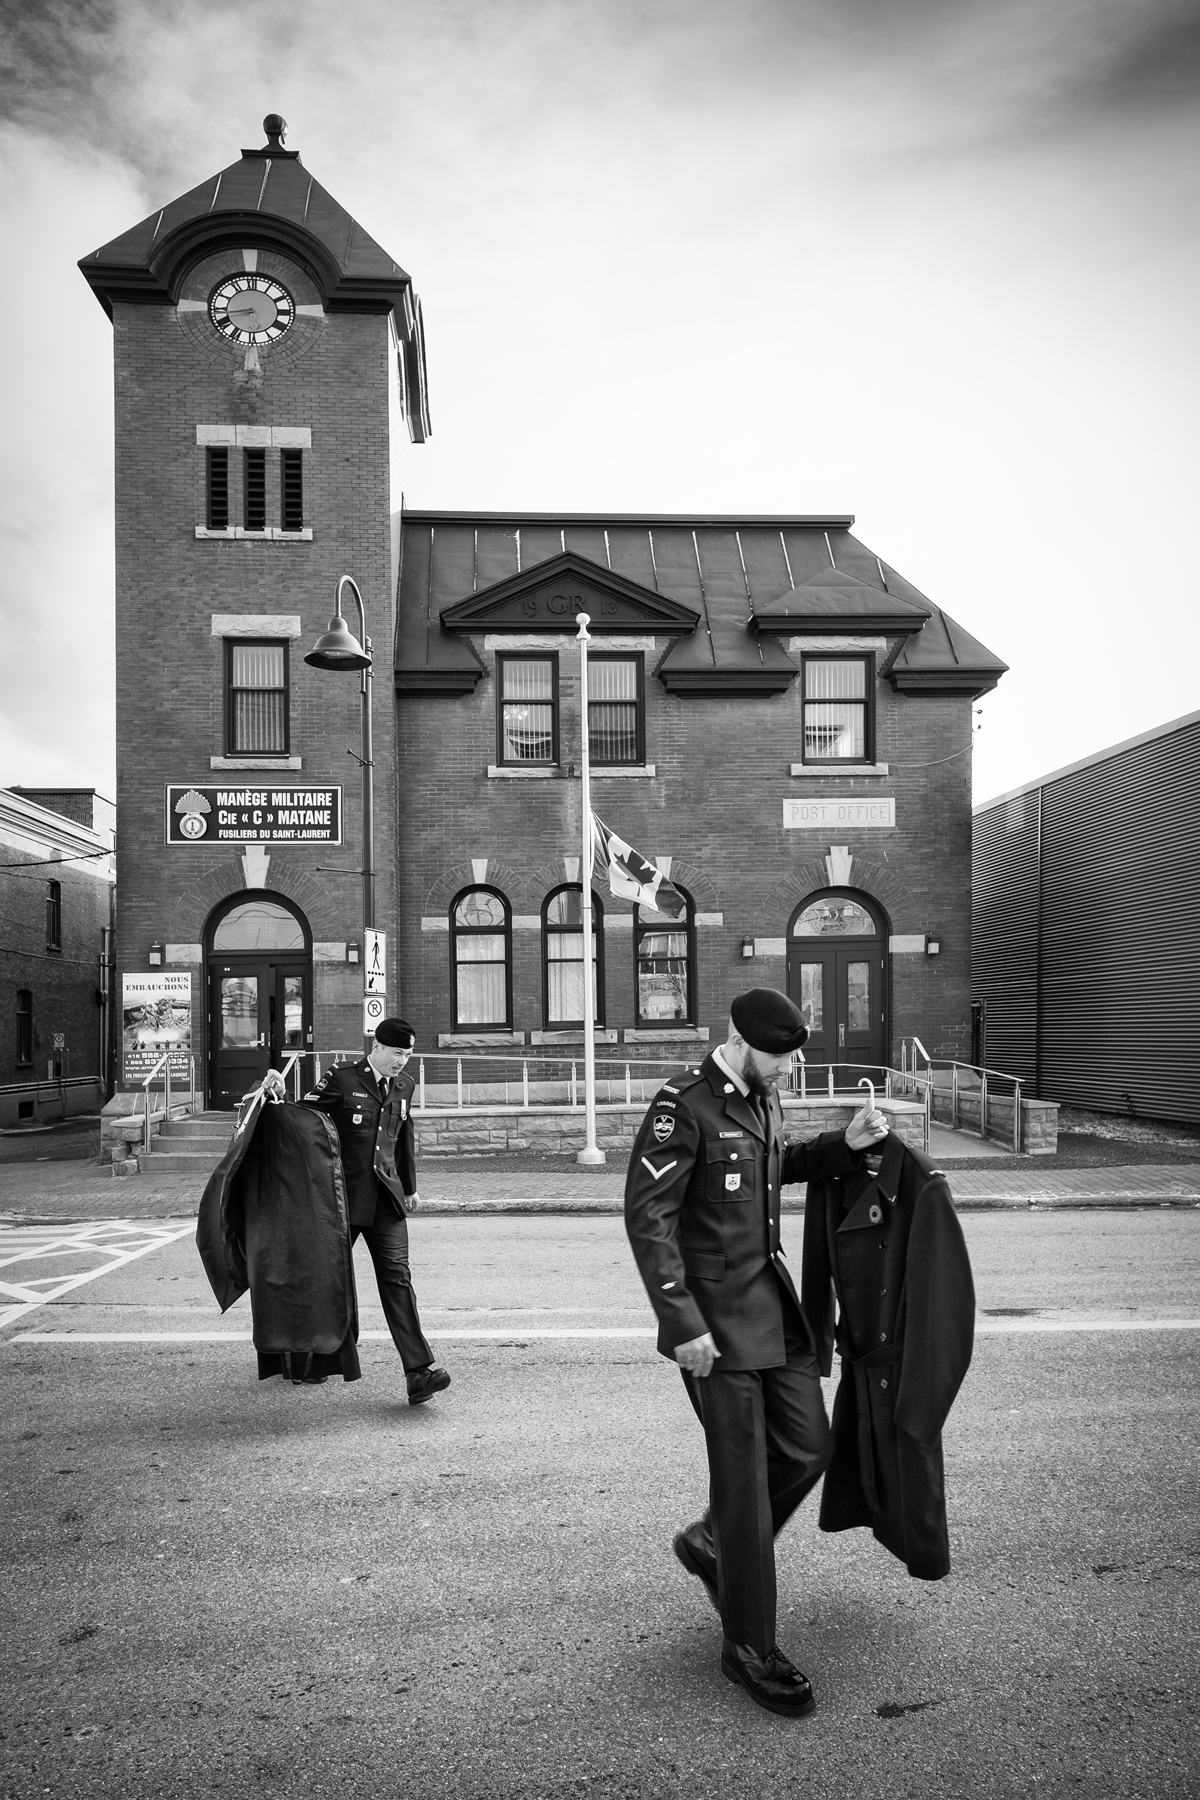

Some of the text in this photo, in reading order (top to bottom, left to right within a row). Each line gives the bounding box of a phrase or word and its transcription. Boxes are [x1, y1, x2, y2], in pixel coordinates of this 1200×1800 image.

[522, 594, 617, 618] 19 GR 13
[217, 790, 332, 806] MANÈGE MILITAIRE
[253, 810, 262, 825] C
[278, 810, 331, 824] MATANE
[792, 806, 887, 820] POST OFFICE
[219, 830, 330, 838] FUSILIERS DU SAINT-LAURENT
